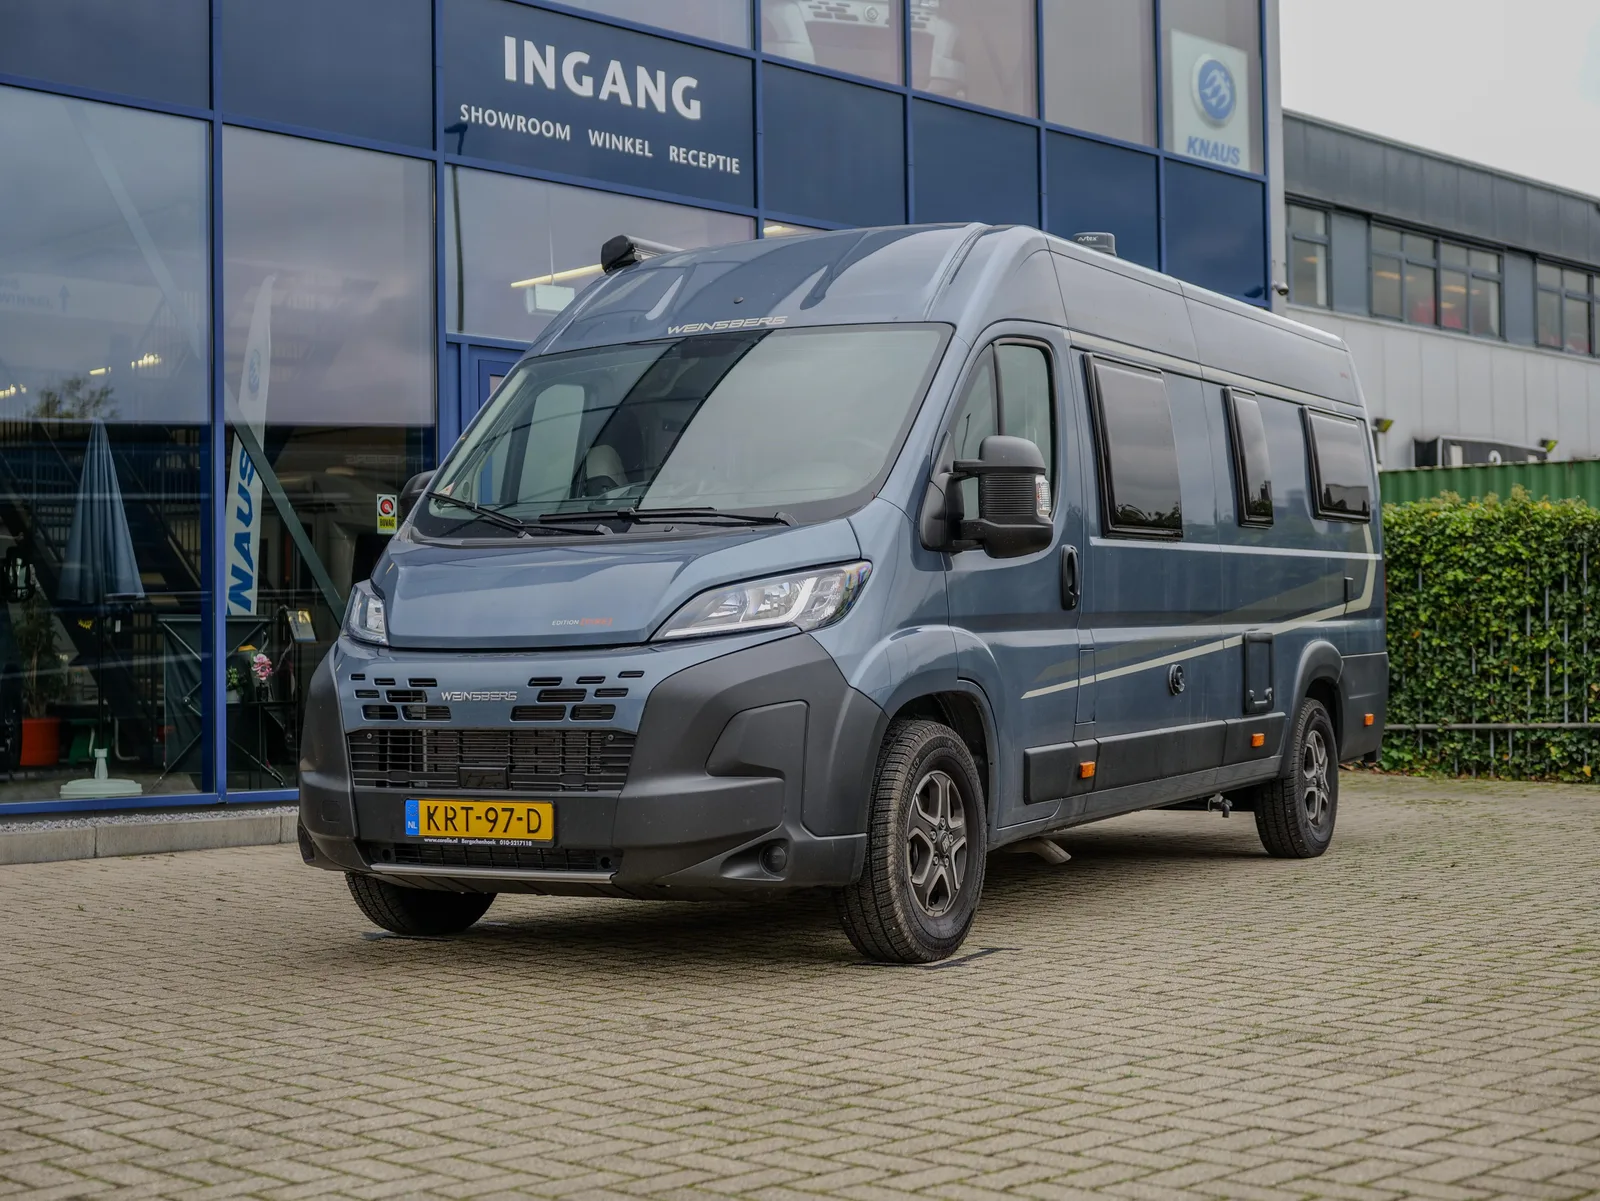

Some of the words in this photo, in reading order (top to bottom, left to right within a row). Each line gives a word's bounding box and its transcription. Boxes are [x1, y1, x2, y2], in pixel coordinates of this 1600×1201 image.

[504, 35, 701, 120] INGANG
[460, 104, 571, 141] SHOWROOM
[588, 129, 653, 157] WINKEL
[669, 145, 741, 174] RECEPTIE
[1187, 135, 1240, 166] KNAUS
[668, 315, 788, 335] WEINSBERG
[227, 446, 255, 615] NAUS
[551, 619, 580, 627] EDITION
[441, 691, 518, 701] WEINSBERG
[407, 821, 418, 829] NL
[426, 805, 542, 834] KRT-97-D
